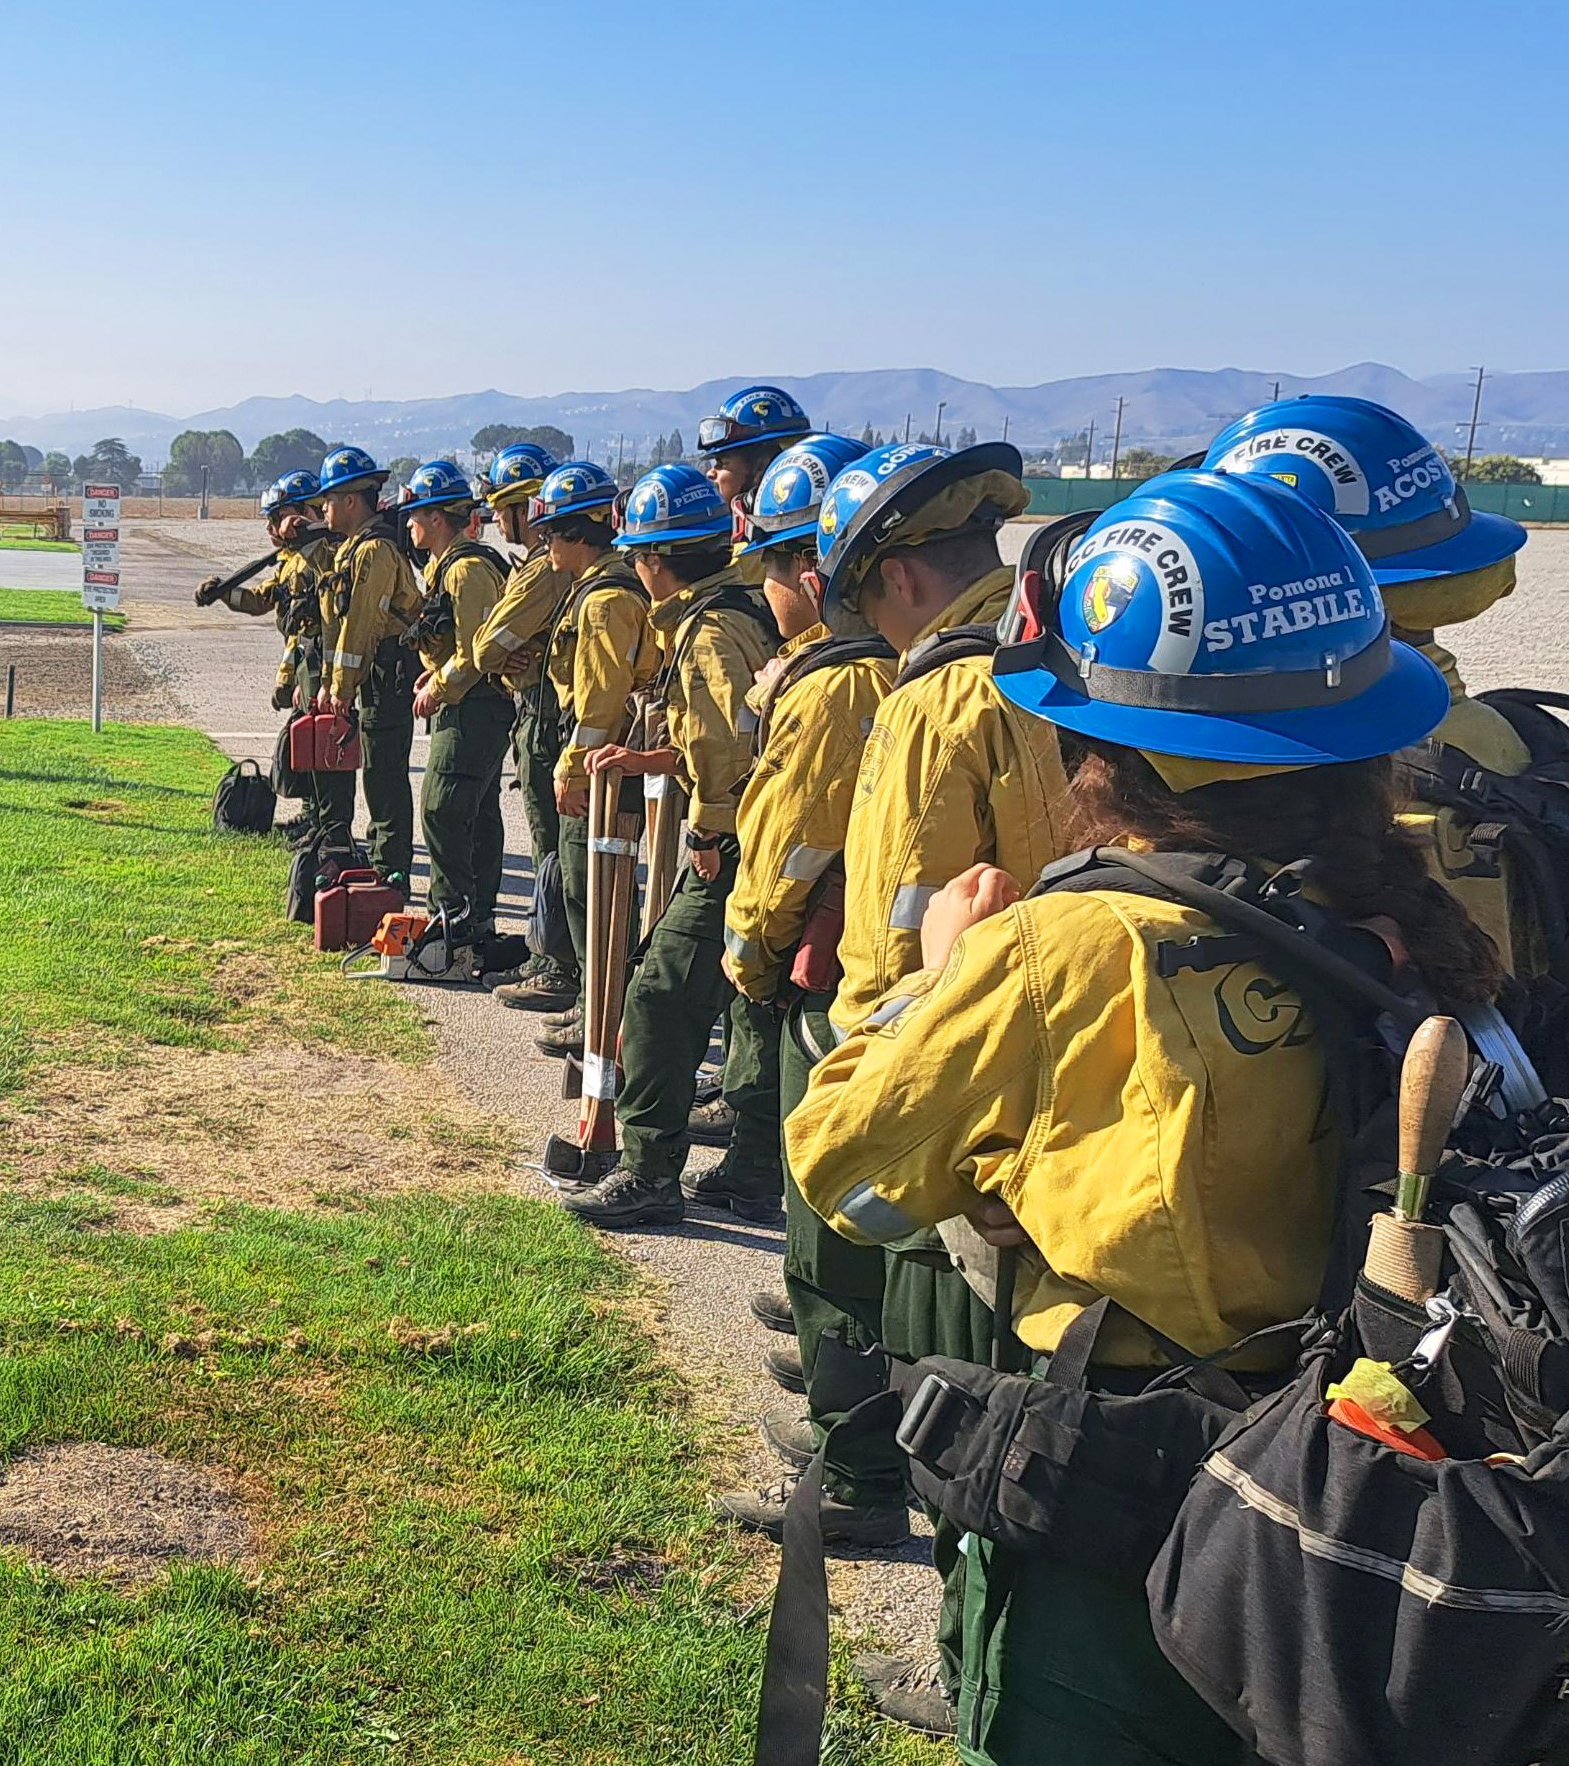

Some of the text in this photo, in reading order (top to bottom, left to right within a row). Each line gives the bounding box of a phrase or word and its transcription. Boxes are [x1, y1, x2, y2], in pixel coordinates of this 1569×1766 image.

[802, 458, 825, 489] CREW
[1295, 437, 1357, 486] CREW
[98, 500, 106, 508] NO
[1103, 528, 1163, 553] FIRE
[1157, 550, 1193, 637] CREW
[1248, 573, 1341, 605] Pomona
[1203, 588, 1371, 653] STABILE,
